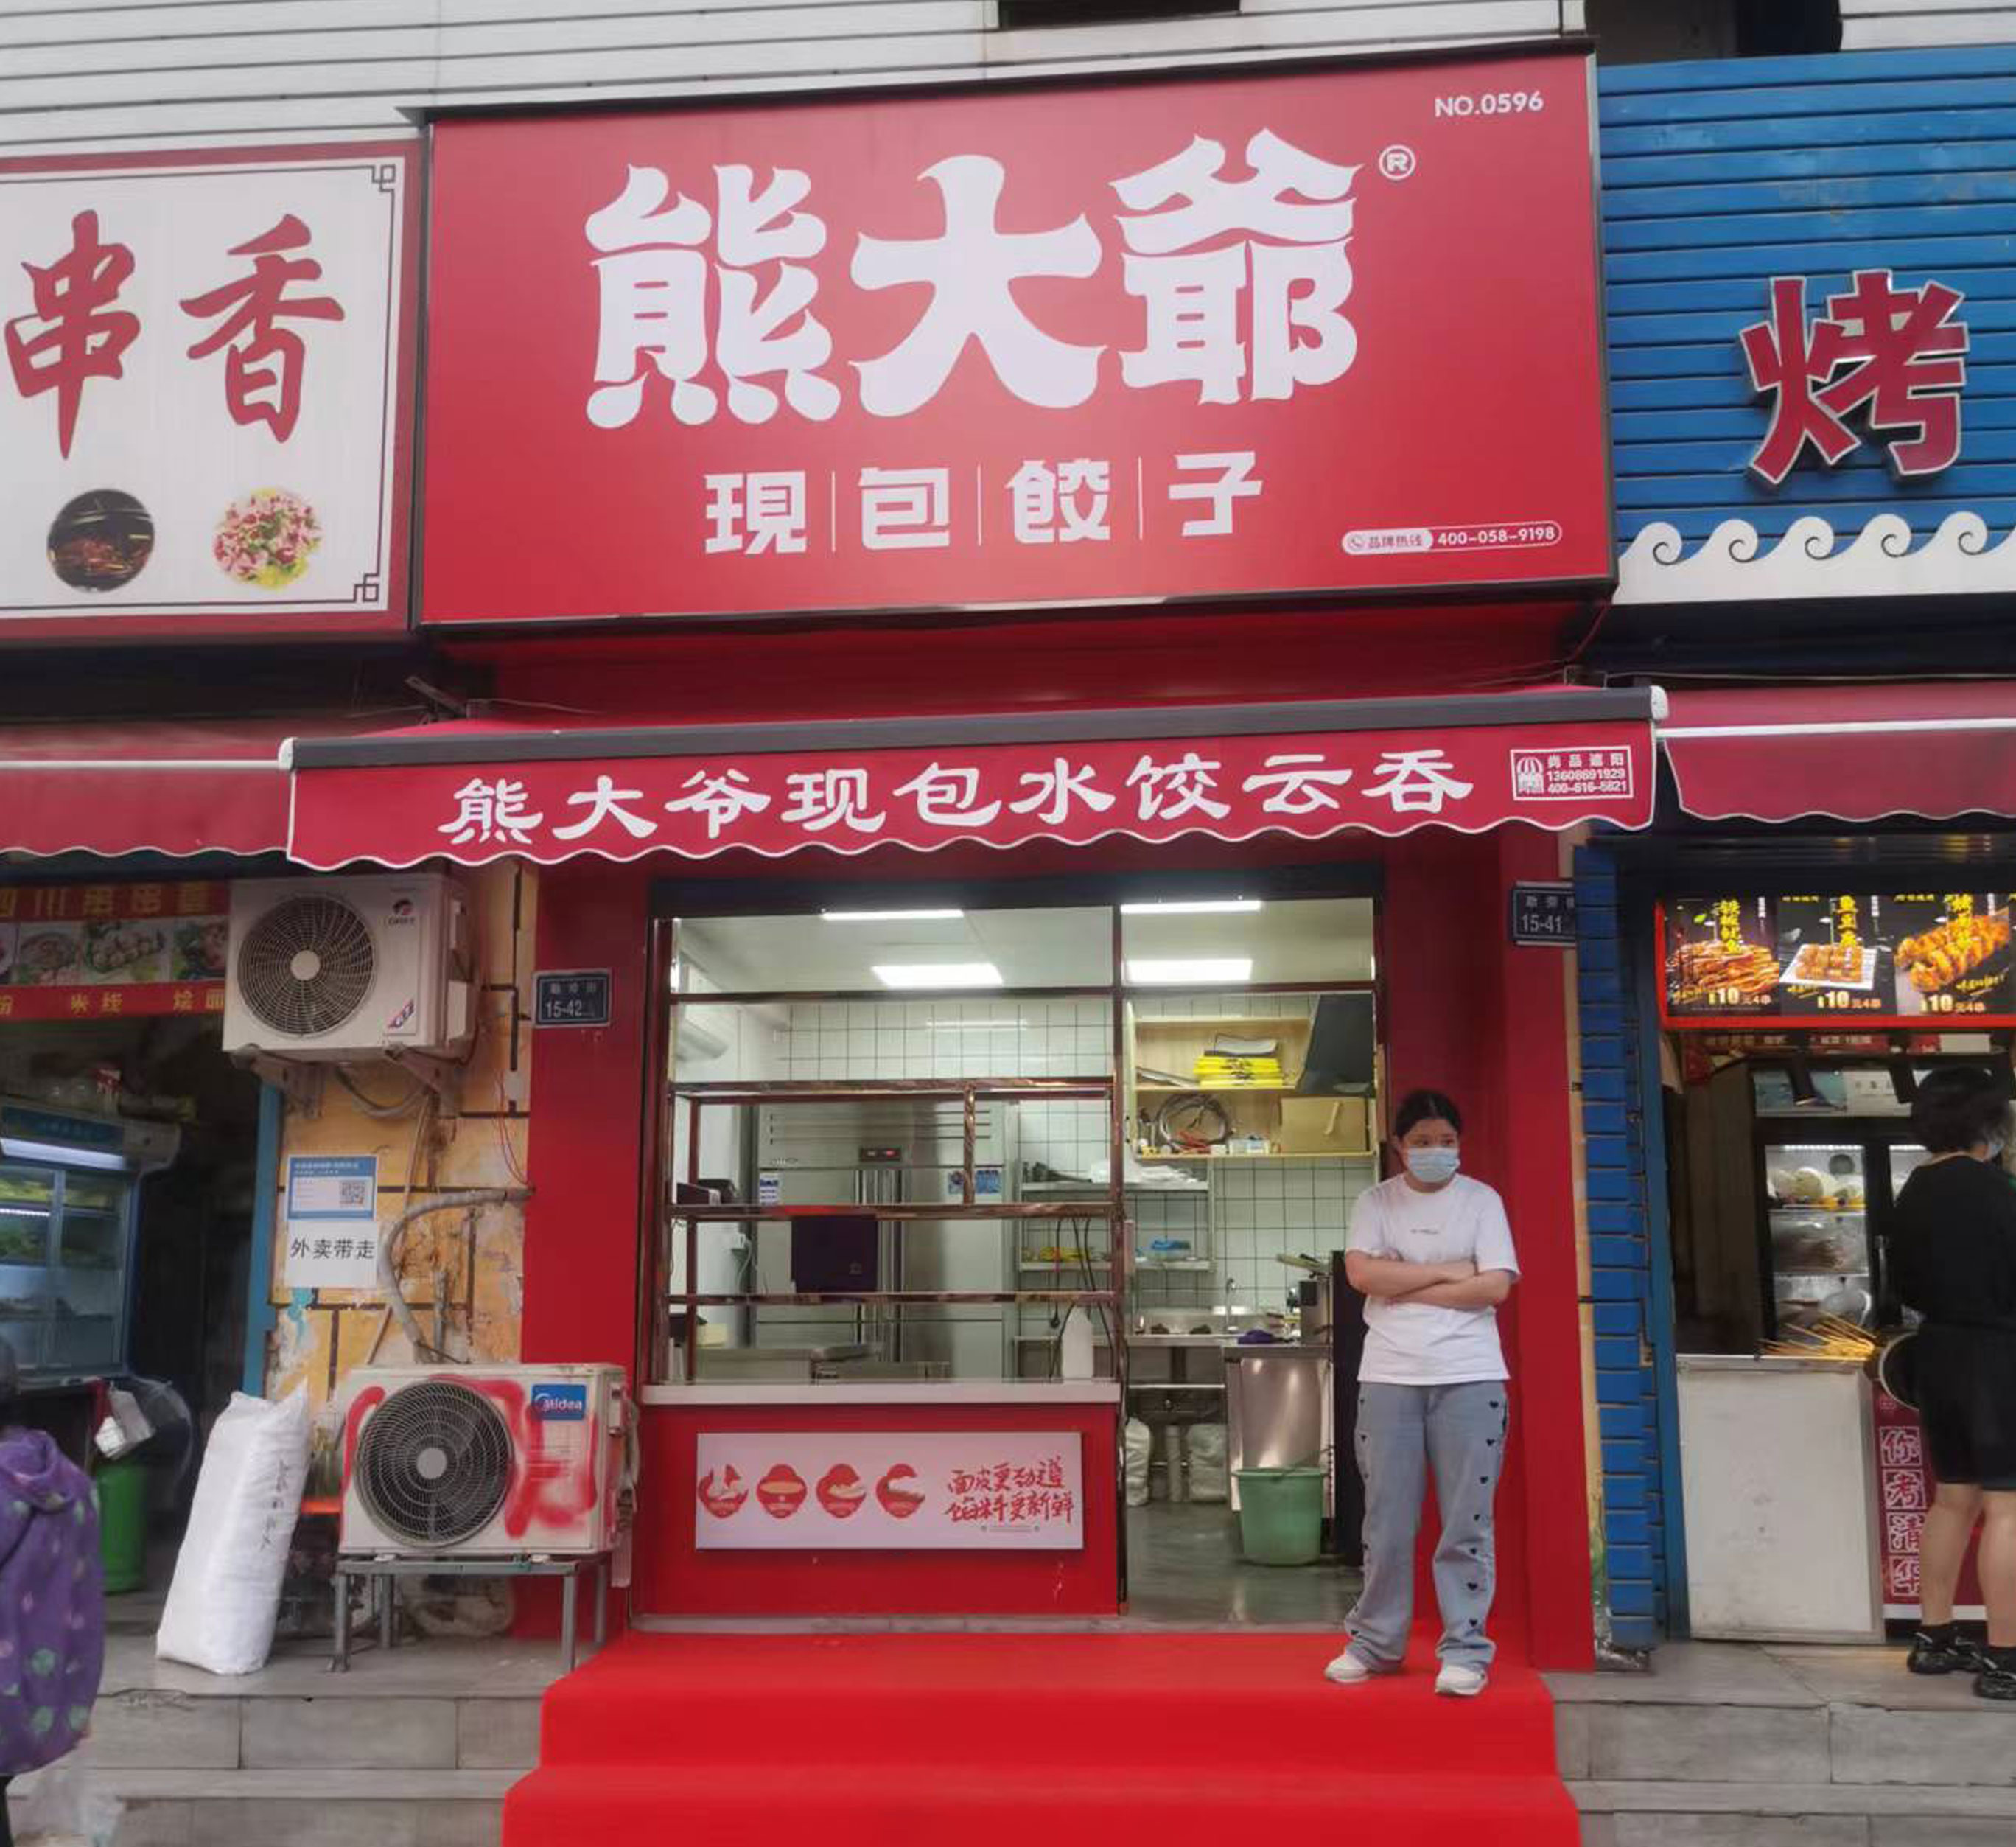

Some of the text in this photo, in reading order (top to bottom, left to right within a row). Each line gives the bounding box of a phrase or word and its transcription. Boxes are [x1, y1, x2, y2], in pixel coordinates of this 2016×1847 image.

[1434, 90, 1544, 118] NO.0596
[4, 209, 345, 459] 串香
[1740, 268, 1970, 486] 烤
[1438, 526, 1555, 546] 400-058-9198
[438, 749, 1473, 845] 熊大爷现包水饺云吞
[1522, 914, 1562, 933] 15-41
[546, 999, 582, 1018] 15-42
[290, 1237, 377, 1260] 外卖带走
